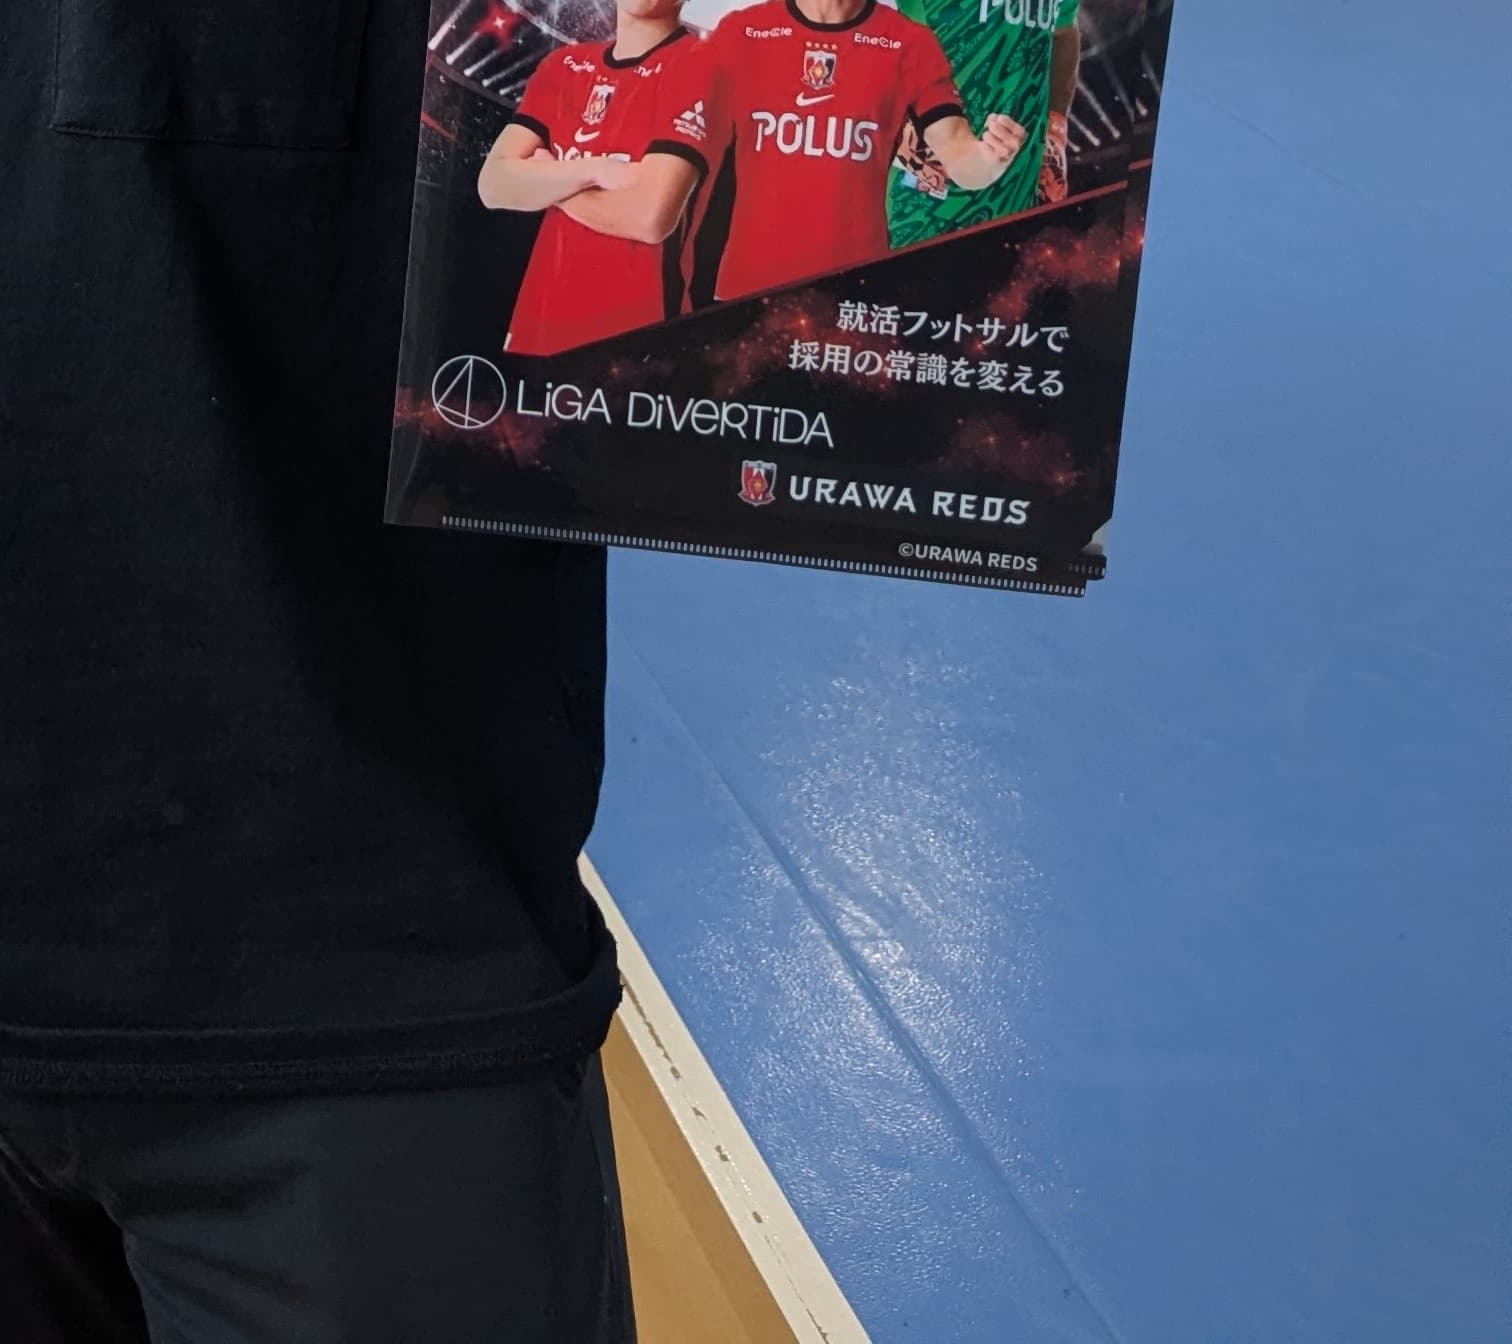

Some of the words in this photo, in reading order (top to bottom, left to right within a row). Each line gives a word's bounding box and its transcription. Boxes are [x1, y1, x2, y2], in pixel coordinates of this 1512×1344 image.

[751, 111, 879, 161] POLUS
[835, 299, 1071, 353] 就活フットサルで
[787, 338, 1065, 397] 採用の常識を変える
[788, 474, 917, 513] URAWA
[931, 490, 1031, 526] REDS
[987, 552, 1039, 573] REDS
